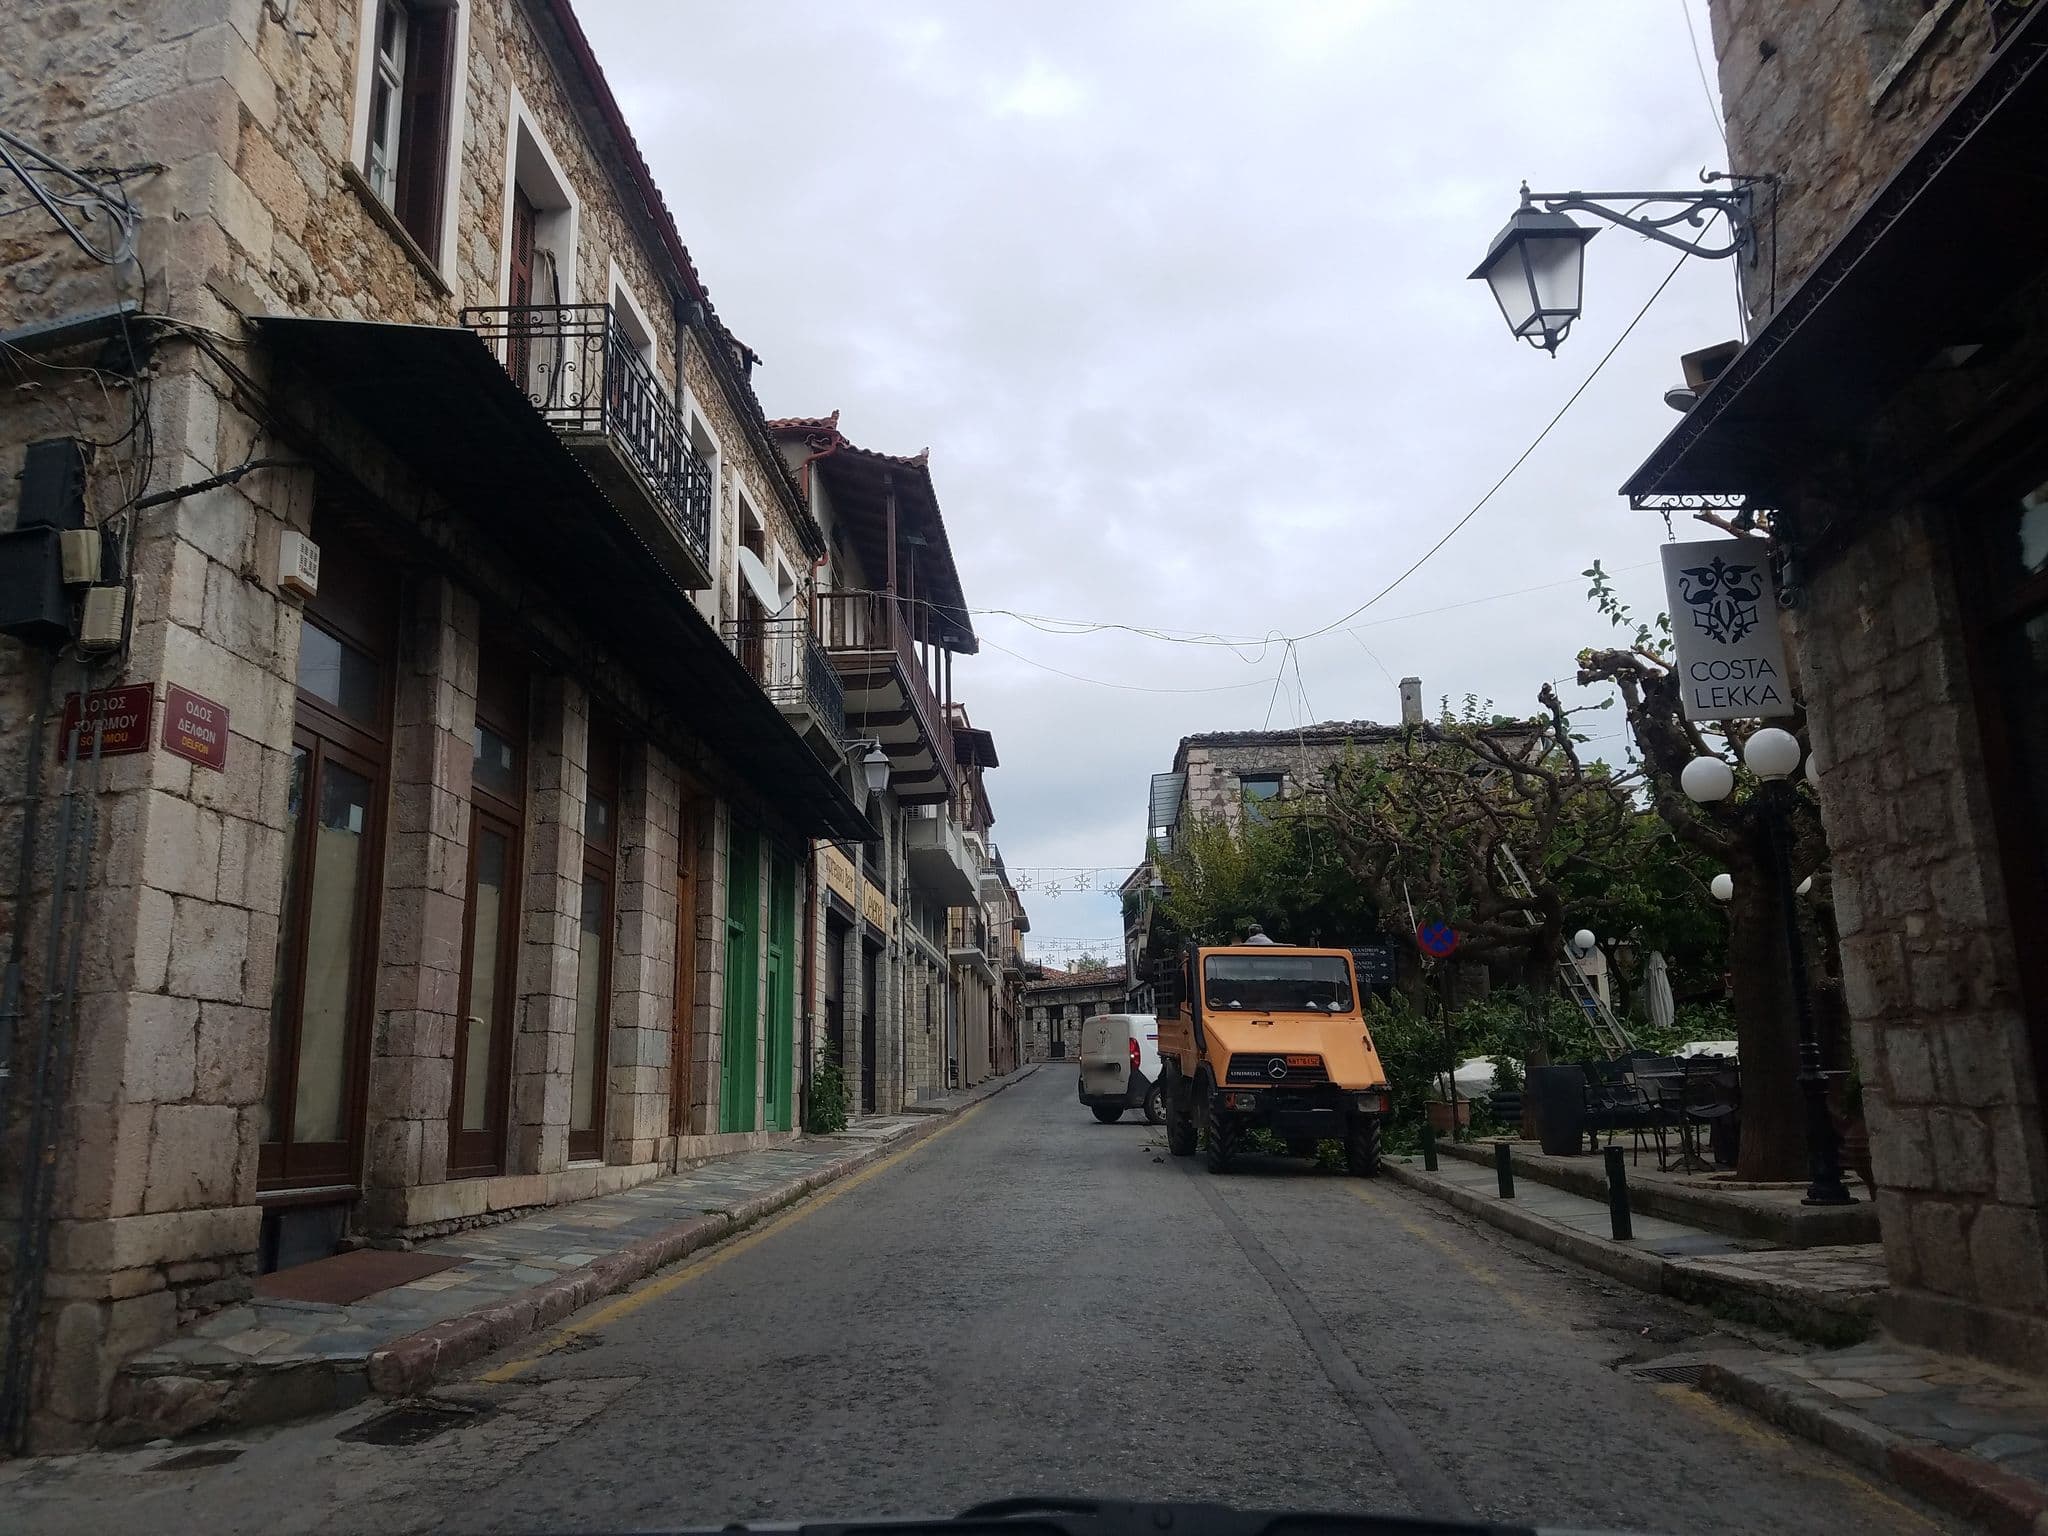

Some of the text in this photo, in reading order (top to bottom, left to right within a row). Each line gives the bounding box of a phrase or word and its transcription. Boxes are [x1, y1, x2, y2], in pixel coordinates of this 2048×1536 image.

[1690, 658, 1777, 681] COSTA
[1695, 685, 1782, 708] LEKKA
[186, 700, 213, 723] ΟΔΟΣ
[177, 718, 216, 744] ΔΕΛΦΩΝ
[181, 736, 209, 753] DELFON
